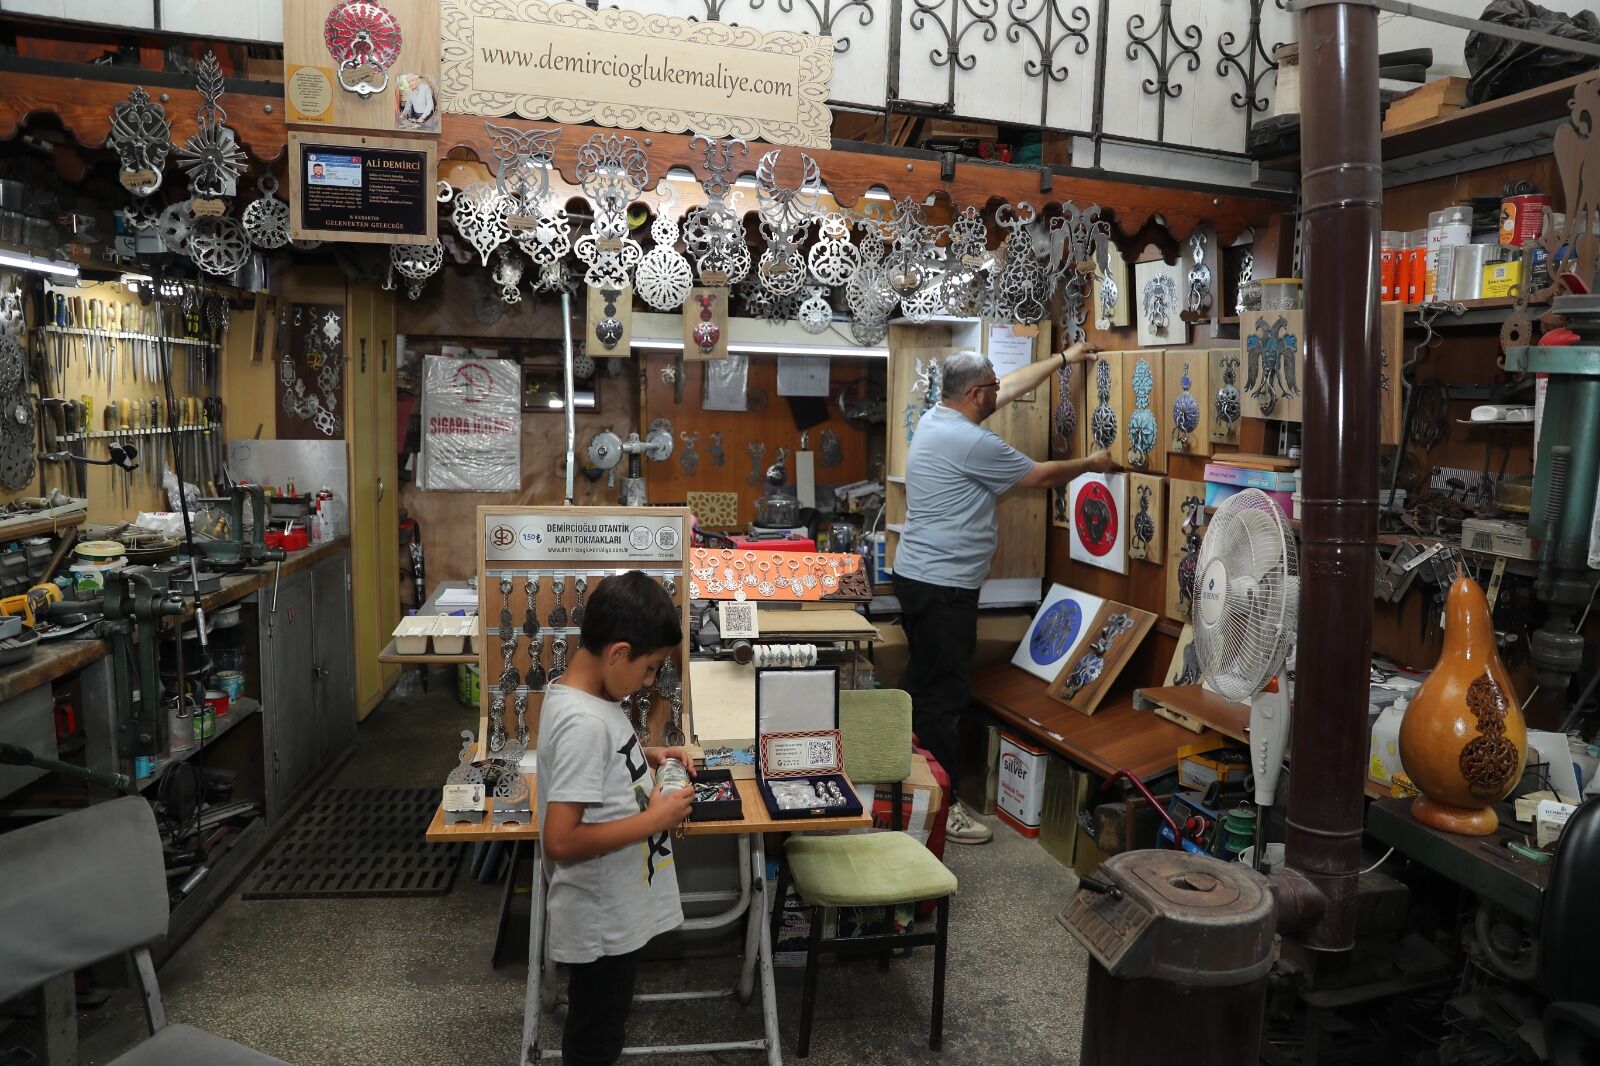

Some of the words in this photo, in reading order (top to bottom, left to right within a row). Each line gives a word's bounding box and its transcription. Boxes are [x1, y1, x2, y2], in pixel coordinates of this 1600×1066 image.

[481, 43, 793, 98] www.demircioglukemaliye.com
[366, 158, 380, 168] ALİ
[383, 160, 420, 171] DEMİRCİ
[546, 523, 597, 533] DEMİRCİOĞLU
[599, 523, 630, 533] OTANTİK
[555, 535, 573, 544] KAPI
[575, 535, 621, 545] TOKMAKLARI
[1004, 759, 1027, 780] silver
